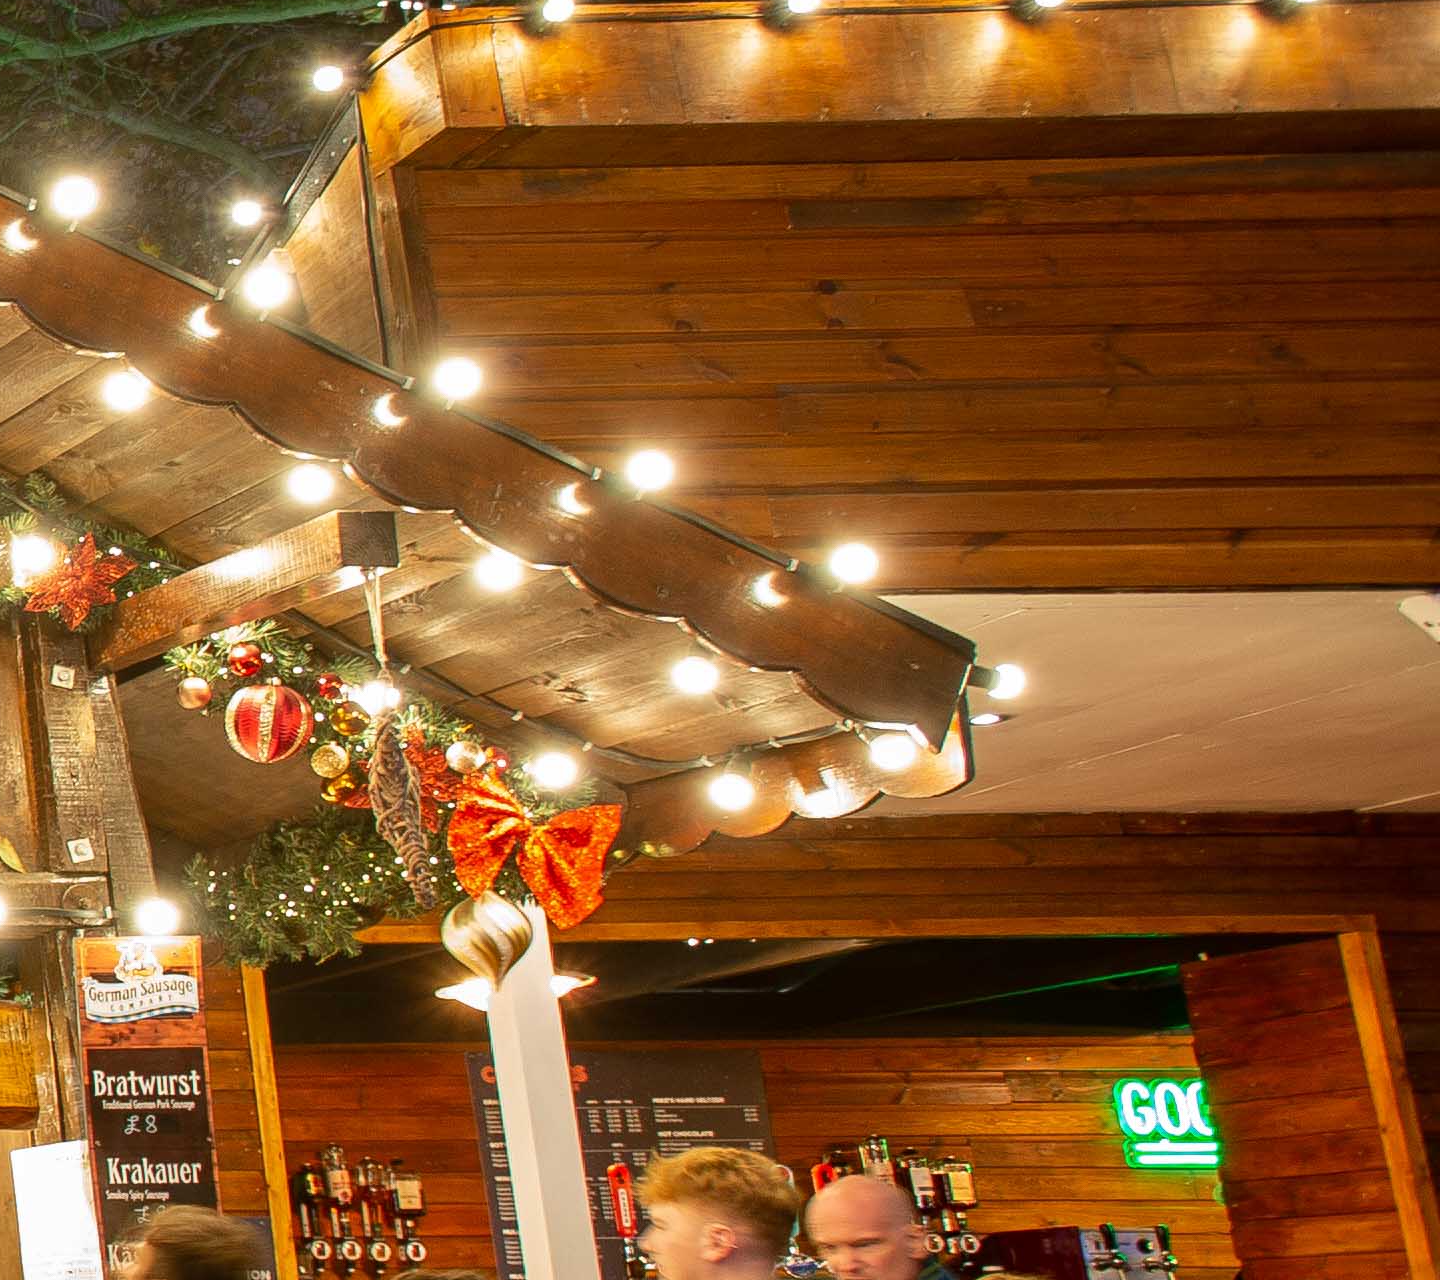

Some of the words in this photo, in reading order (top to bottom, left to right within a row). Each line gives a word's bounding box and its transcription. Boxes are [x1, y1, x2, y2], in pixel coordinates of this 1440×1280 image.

[88, 986, 137, 1002] German
[139, 979, 193, 997] Sausage
[110, 994, 173, 1012] COMPANY
[92, 1070, 201, 1097] Bratwurst
[106, 1157, 202, 1185] Krakauer
